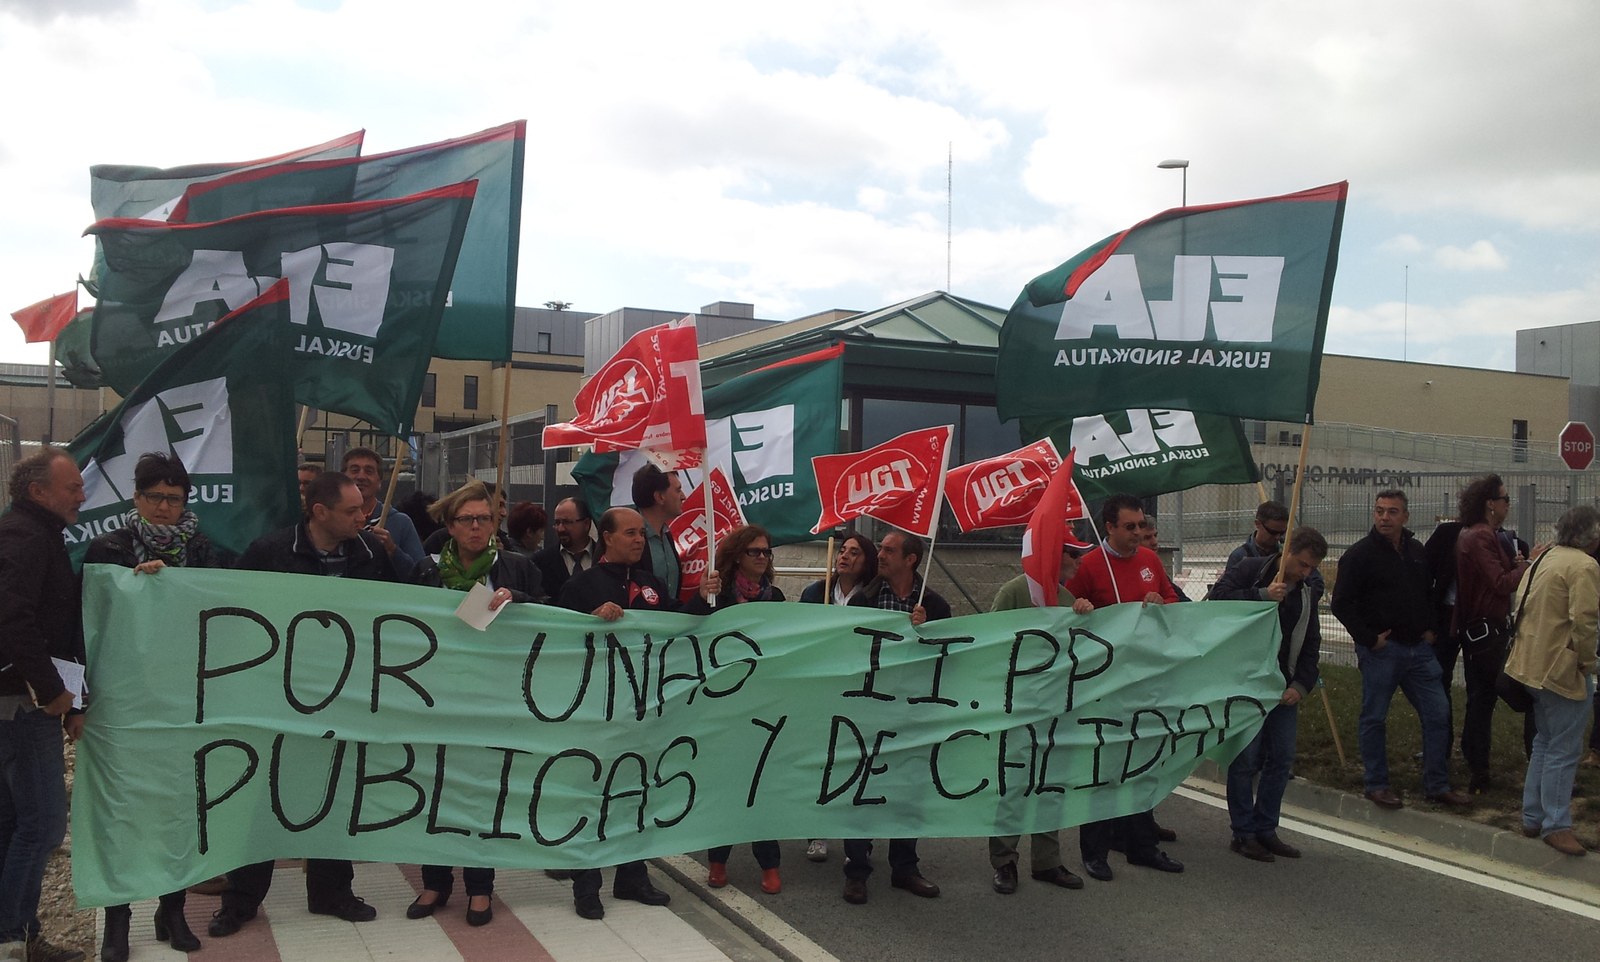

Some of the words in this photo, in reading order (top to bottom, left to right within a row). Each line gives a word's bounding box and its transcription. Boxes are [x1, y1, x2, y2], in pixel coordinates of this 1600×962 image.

[1564, 441, 1592, 453] STOP
[847, 457, 916, 504] UGT
[971, 460, 1033, 512] UGT
[195, 607, 438, 724] POR
[522, 630, 764, 724] UNAS
[194, 729, 700, 856] PÚBLICAS
[746, 714, 788, 809] Y
[816, 715, 898, 806] DE
